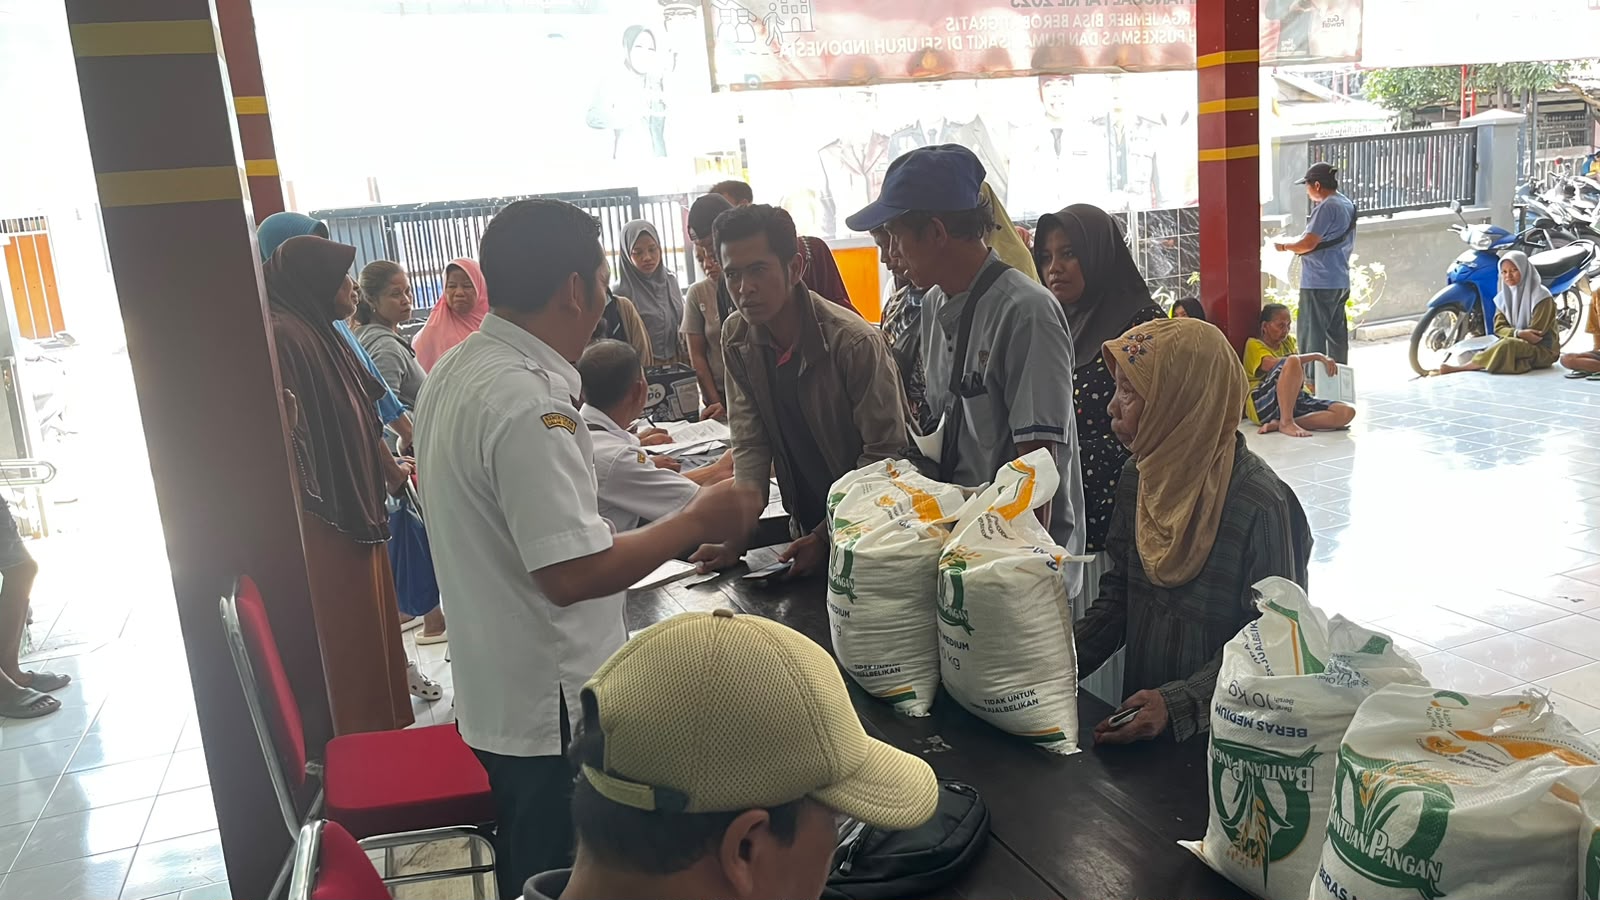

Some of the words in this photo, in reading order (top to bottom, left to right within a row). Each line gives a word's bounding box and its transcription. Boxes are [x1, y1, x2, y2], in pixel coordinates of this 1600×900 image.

[942, 634, 970, 651] MEDIUM
[984, 697, 1006, 705] TIDAK
[1007, 689, 1036, 702] UNTUK
[1228, 679, 1249, 706] kg
[1252, 692, 1275, 711] 10
[1214, 702, 1256, 728] MEDIUM
[1256, 721, 1308, 738] BERAS
[1244, 761, 1314, 792] BANTUAN
[1328, 793, 1368, 854] BANTUAN
[1367, 828, 1442, 882] PANGAN
